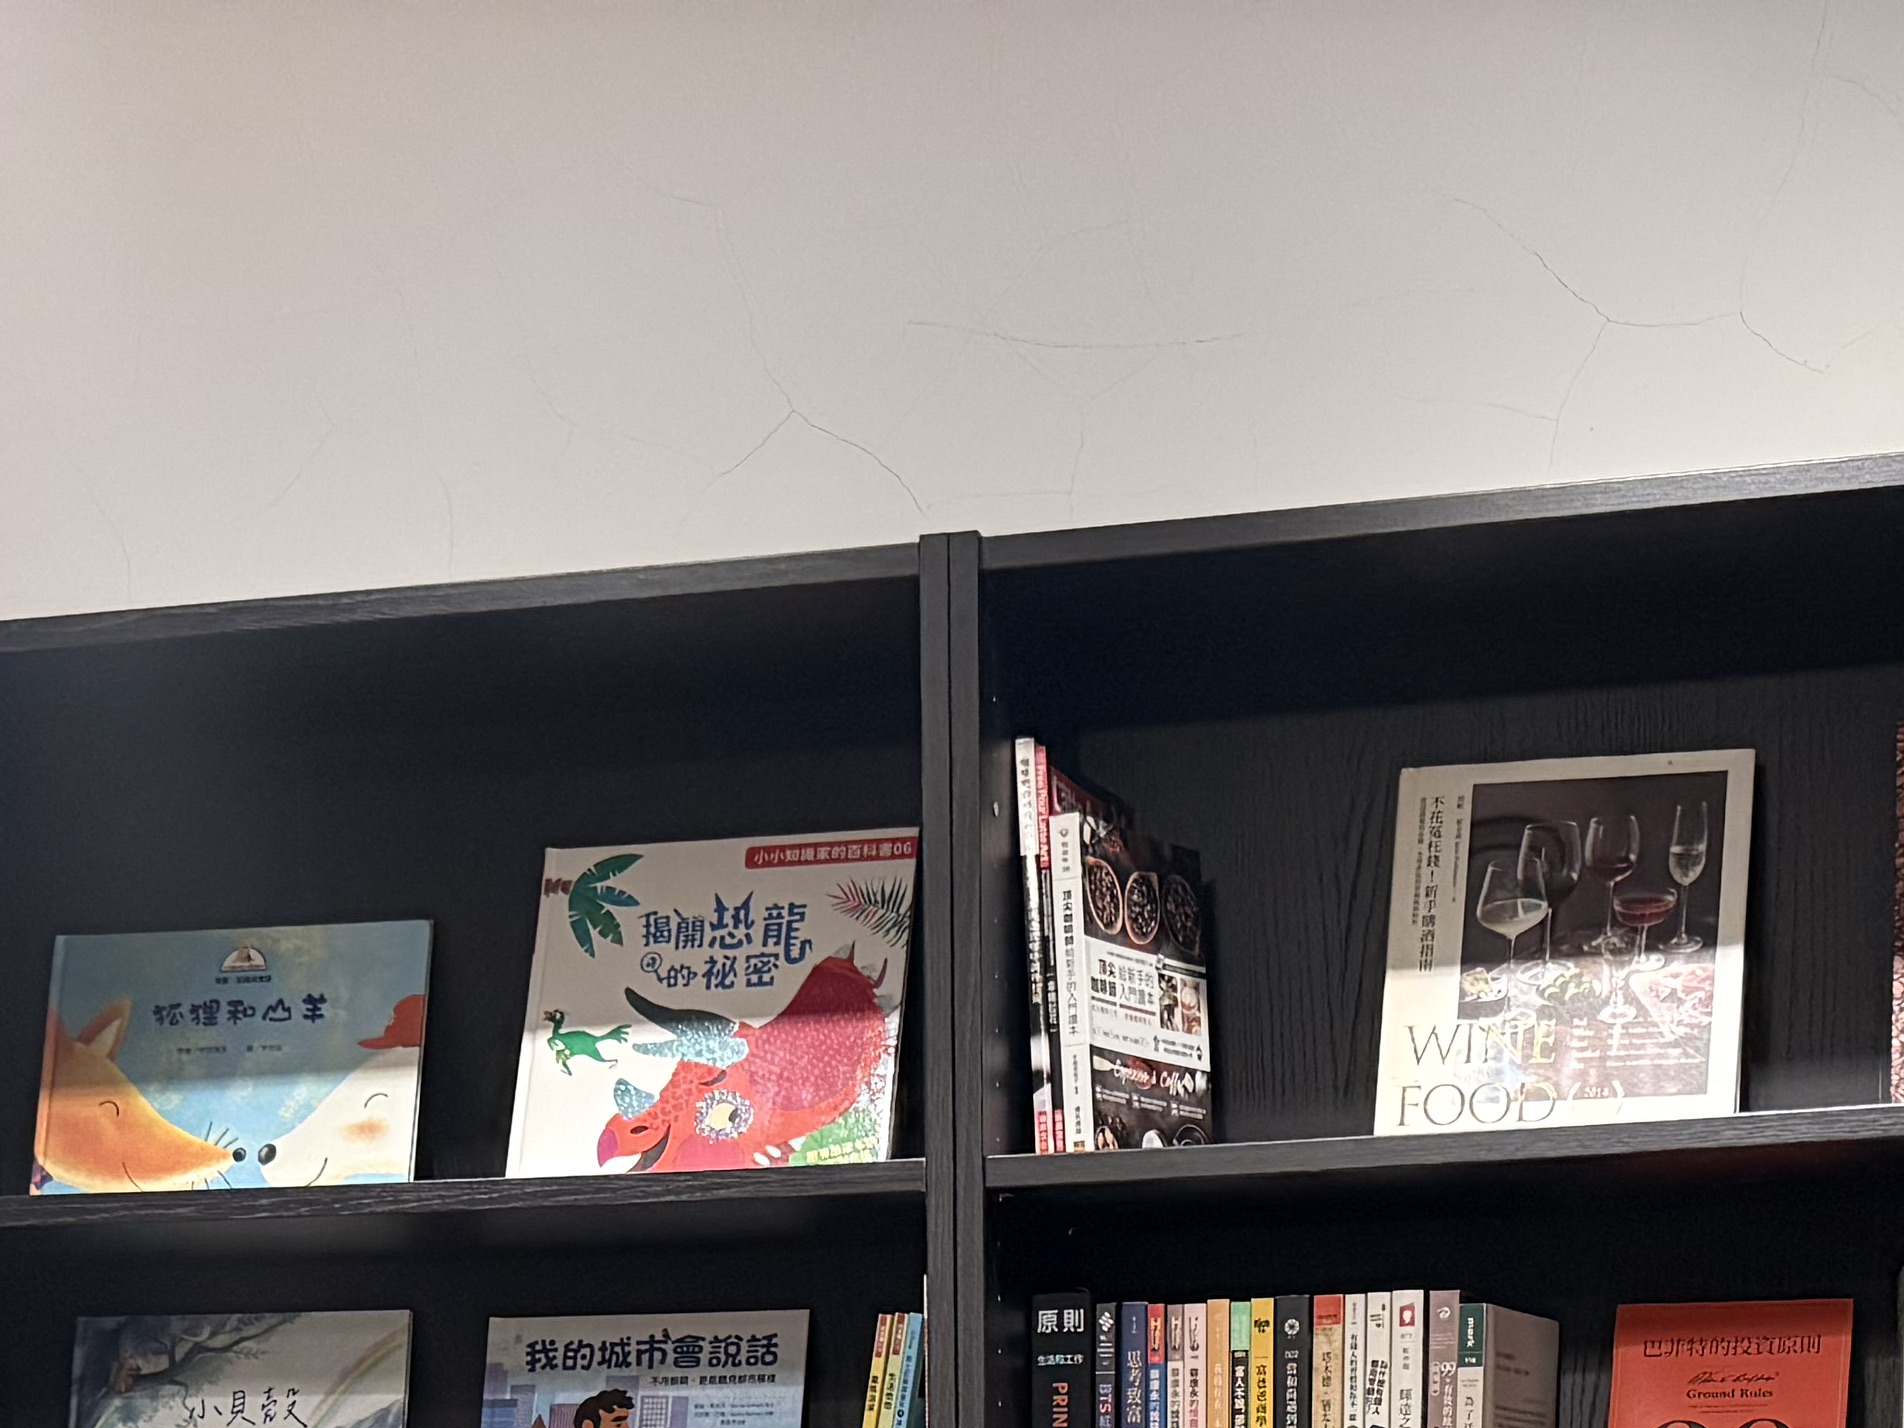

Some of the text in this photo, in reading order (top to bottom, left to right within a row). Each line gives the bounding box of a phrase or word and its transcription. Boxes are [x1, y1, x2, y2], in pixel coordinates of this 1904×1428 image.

[640, 891, 814, 965] 揭開恐龍
[150, 995, 329, 1027] 狐狸和山羊
[1404, 1019, 1556, 1067] WINE
[1398, 1080, 1557, 1127] FOOD
[1037, 1307, 1085, 1334] 原則
[525, 1332, 779, 1372] 我的城市會說話
[1642, 1332, 1822, 1358] 巴菲特的投資原則
[191, 1387, 307, 1428] 小貝殼
[1685, 1387, 1775, 1401] Ground Rules
